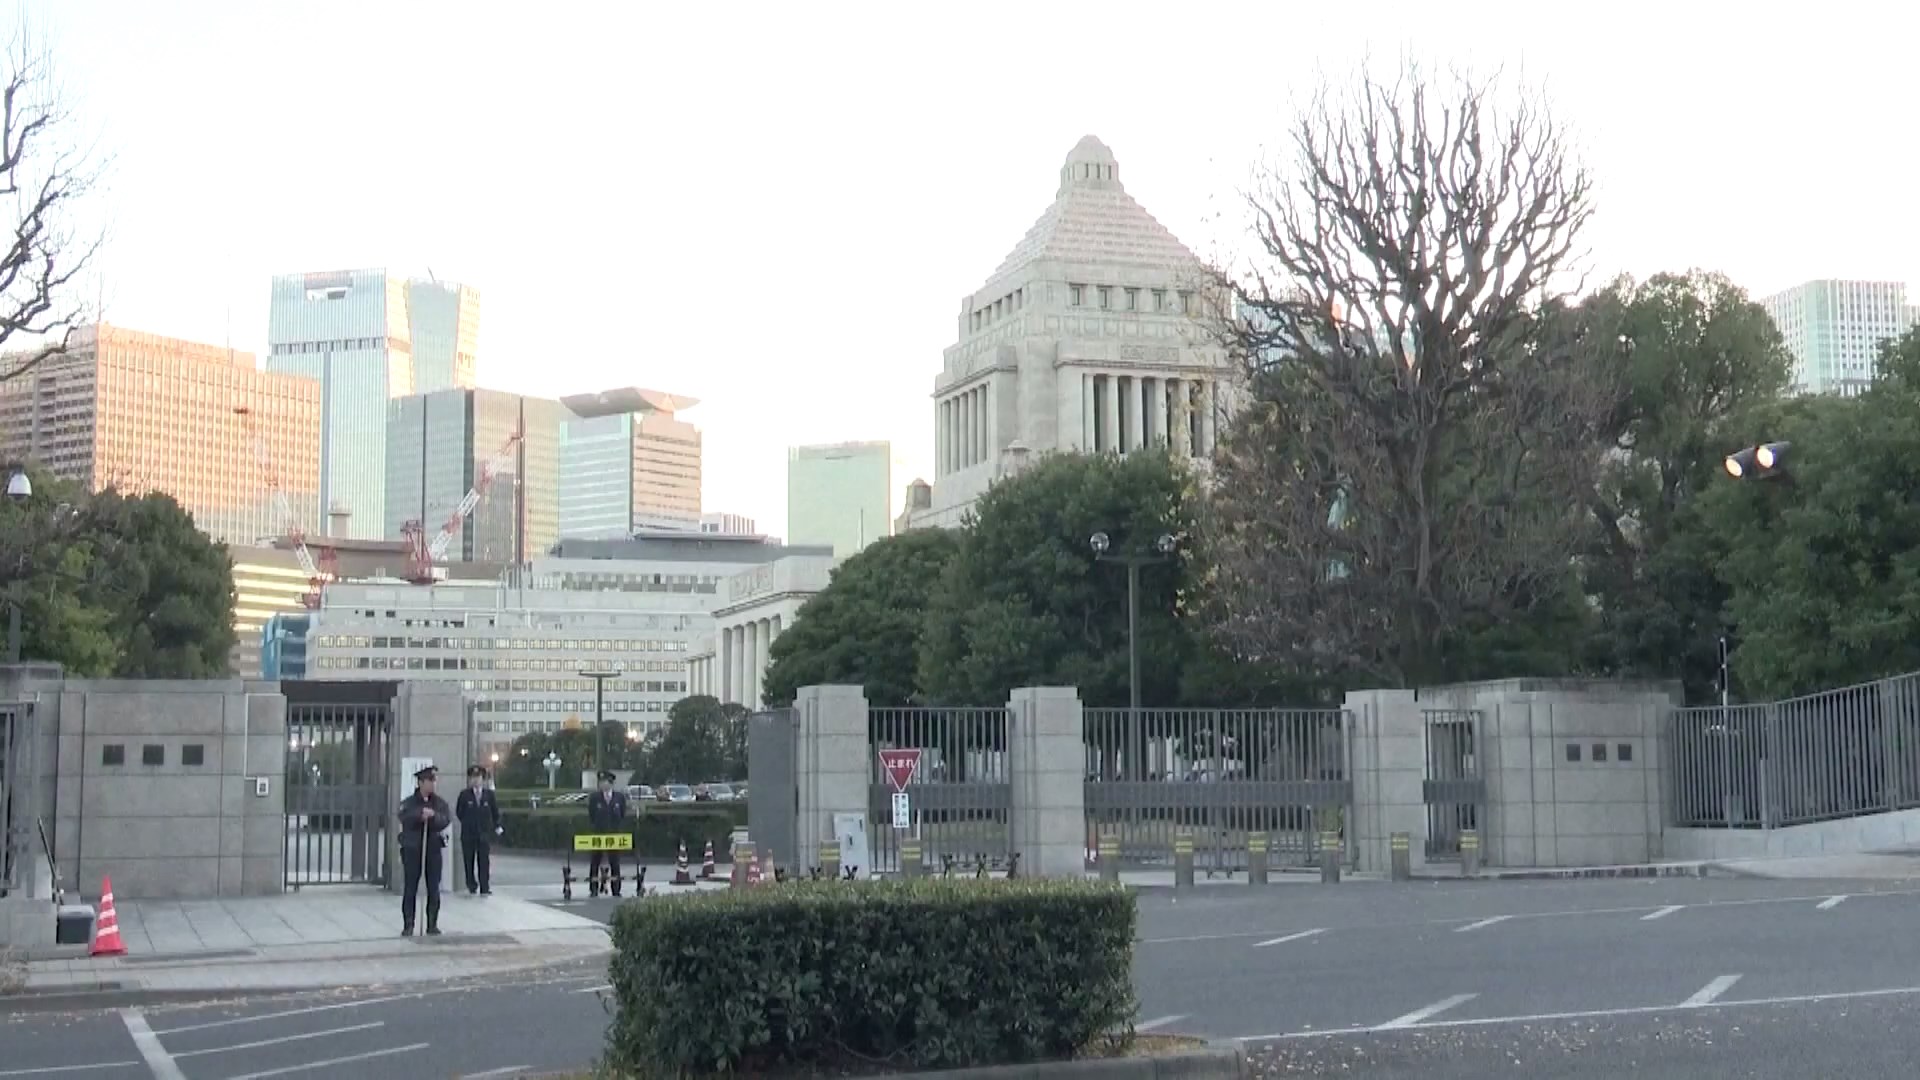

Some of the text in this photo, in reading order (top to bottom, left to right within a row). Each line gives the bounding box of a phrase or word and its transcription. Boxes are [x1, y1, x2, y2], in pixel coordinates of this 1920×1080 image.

[888, 758, 914, 768] 止まれ
[579, 837, 628, 848] 一時停止
